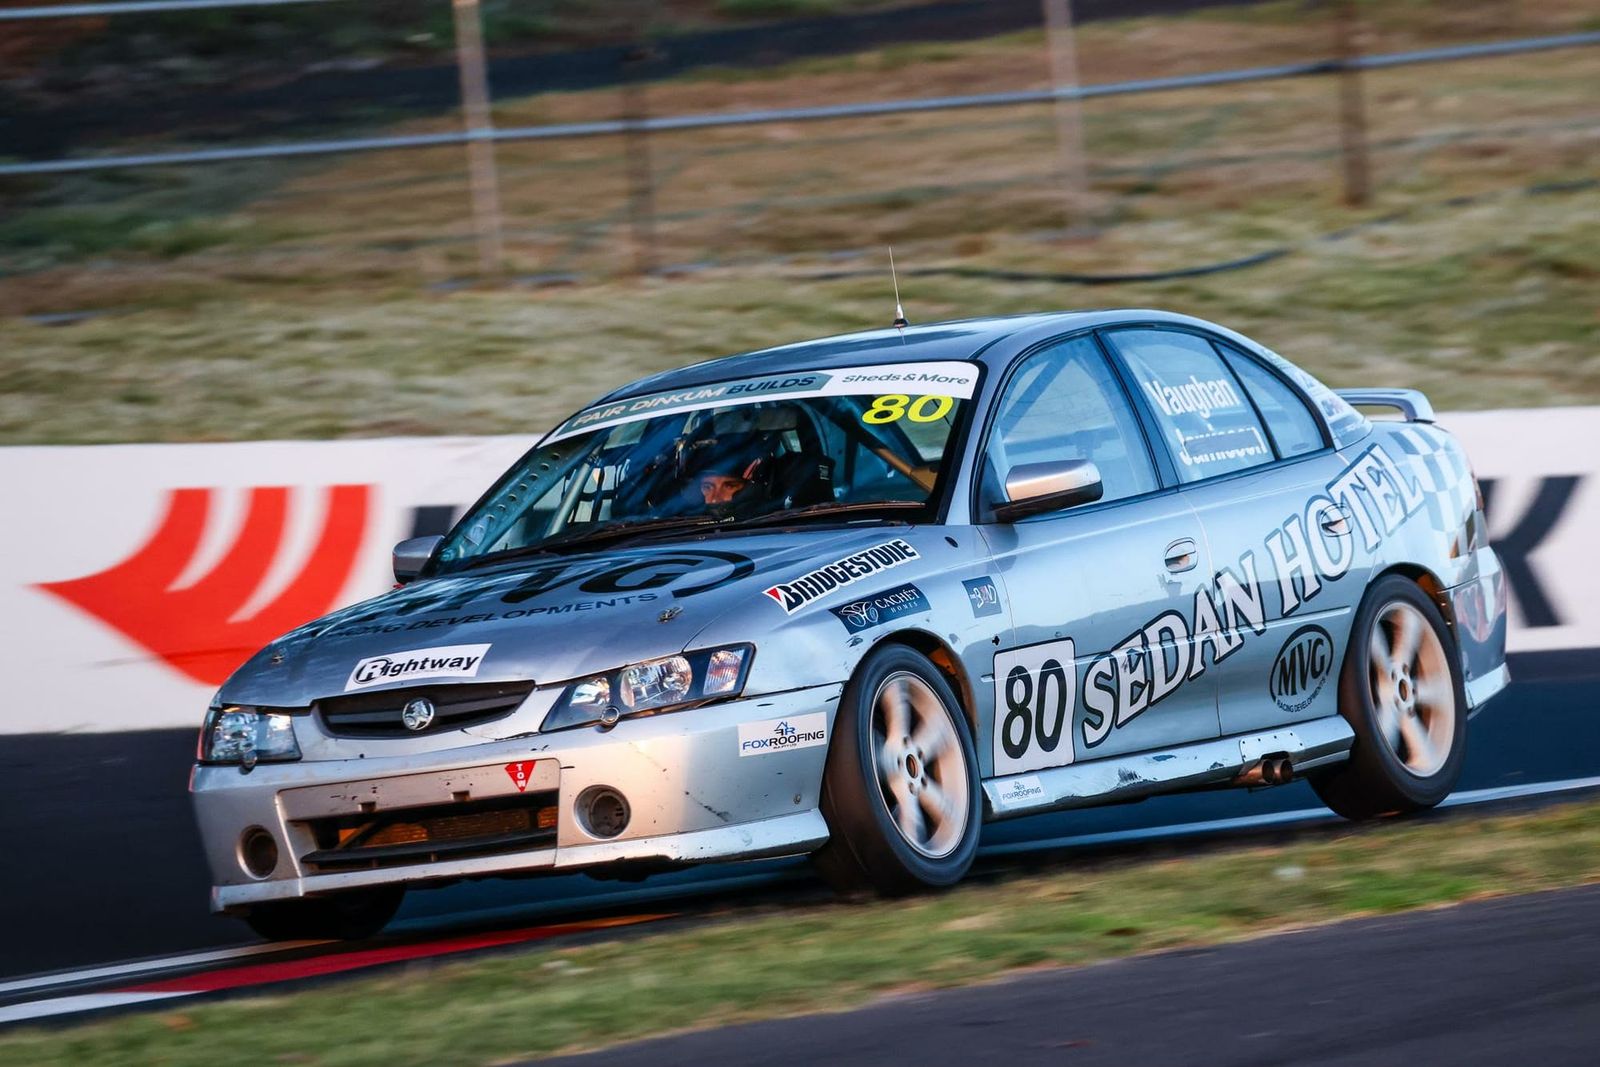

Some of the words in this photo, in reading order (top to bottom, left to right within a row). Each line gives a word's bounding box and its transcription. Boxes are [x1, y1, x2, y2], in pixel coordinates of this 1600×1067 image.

[842, 373, 902, 383] Sheds
[916, 373, 970, 385] More
[1143, 375, 1241, 419] Vaughan
[572, 405, 626, 427] FAIR
[629, 386, 727, 412] DINKUM
[726, 376, 816, 395] BUILDS
[861, 393, 954, 425] 80
[766, 540, 917, 612] BRIDGESTONE
[406, 593, 659, 630] DEVELOPMENTS
[890, 602, 919, 614] HOMES
[1081, 551, 1266, 749] SEDAN
[1263, 442, 1426, 617] HOTEL
[354, 656, 479, 684] Rightway
[1277, 637, 1325, 696] MVG
[1002, 658, 1067, 759] 80
[742, 730, 825, 750] FOXROOFING
[515, 763, 526, 788] TOW
